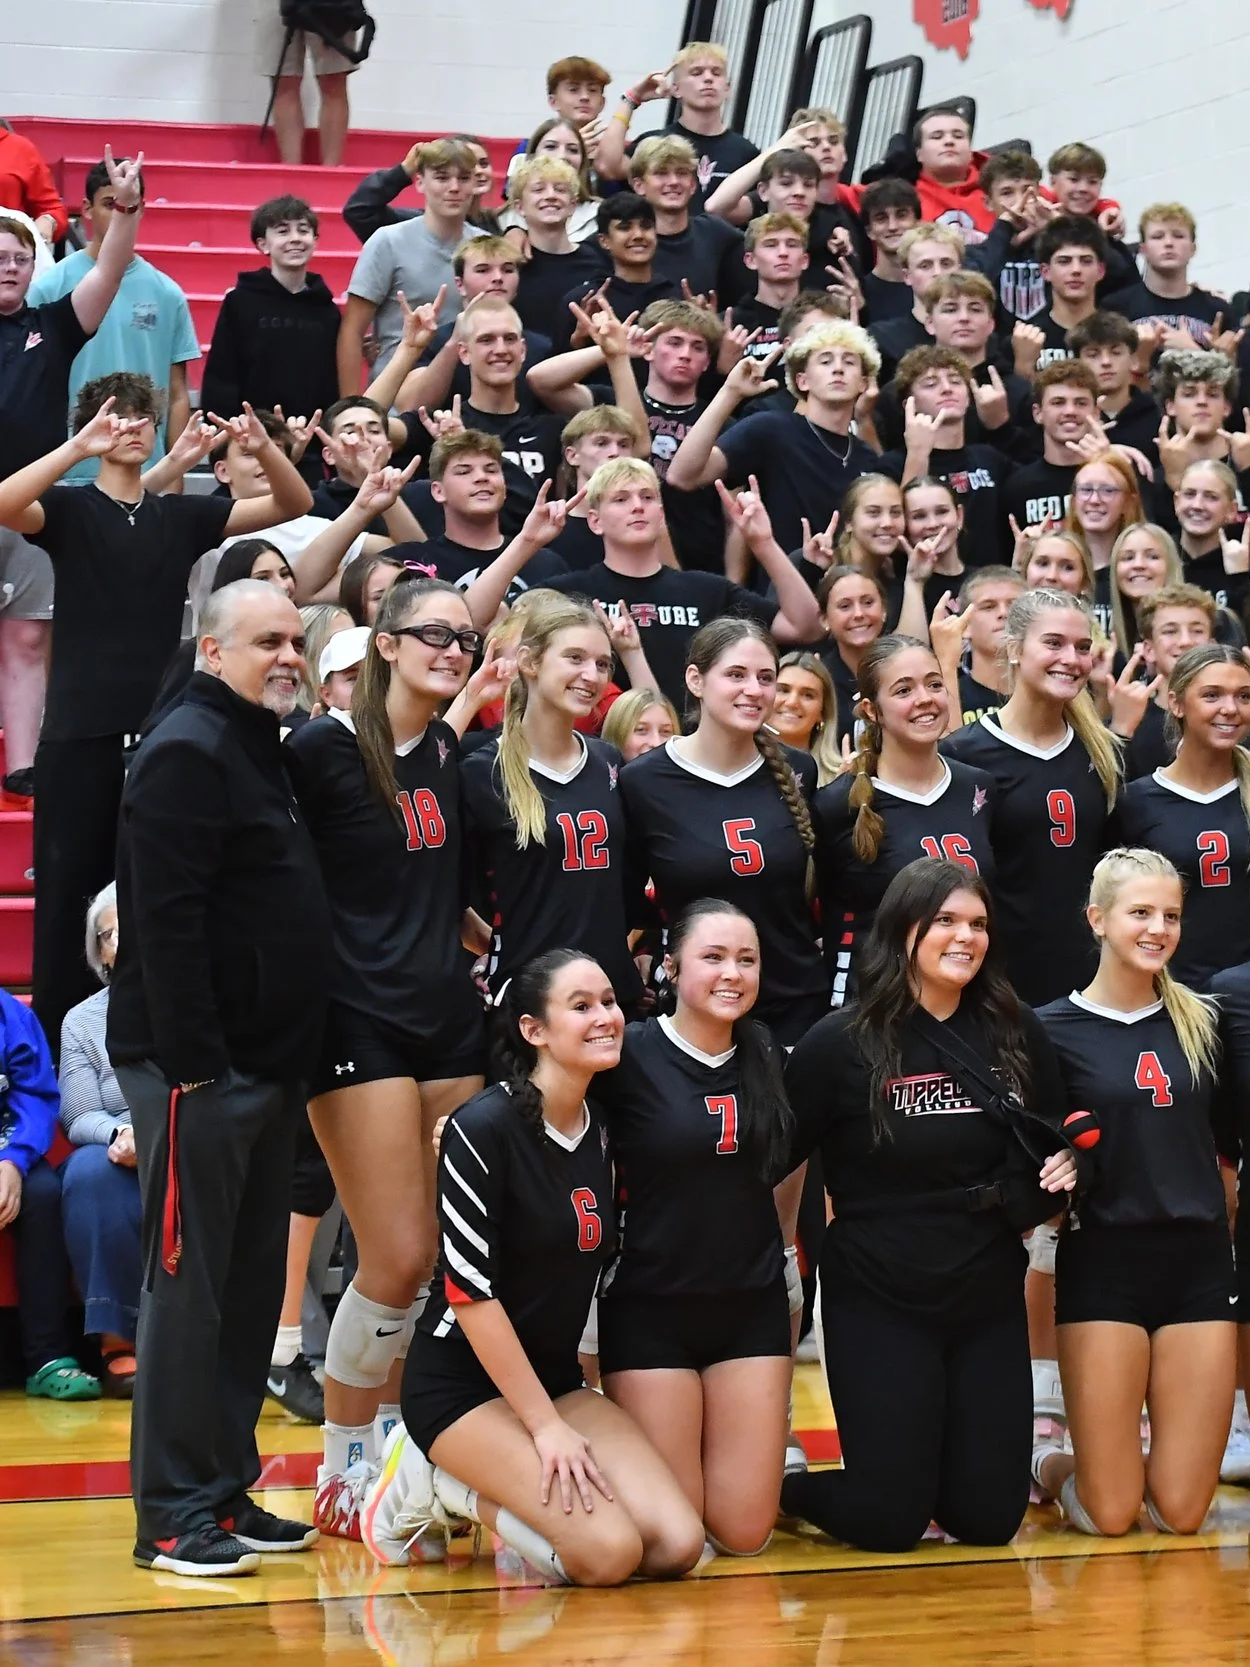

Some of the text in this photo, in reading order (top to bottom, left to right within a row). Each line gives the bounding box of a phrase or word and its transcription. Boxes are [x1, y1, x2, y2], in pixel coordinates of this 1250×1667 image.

[1026, 495, 1061, 523] RED
[599, 601, 700, 627] UTURE
[397, 788, 446, 850] 18
[557, 809, 609, 871] 12
[723, 817, 764, 876] 5
[1046, 789, 1076, 847] 9
[1197, 830, 1230, 887] 2
[1135, 1051, 1173, 1107] 4
[705, 1094, 738, 1154] 7
[570, 1187, 603, 1251] 6
